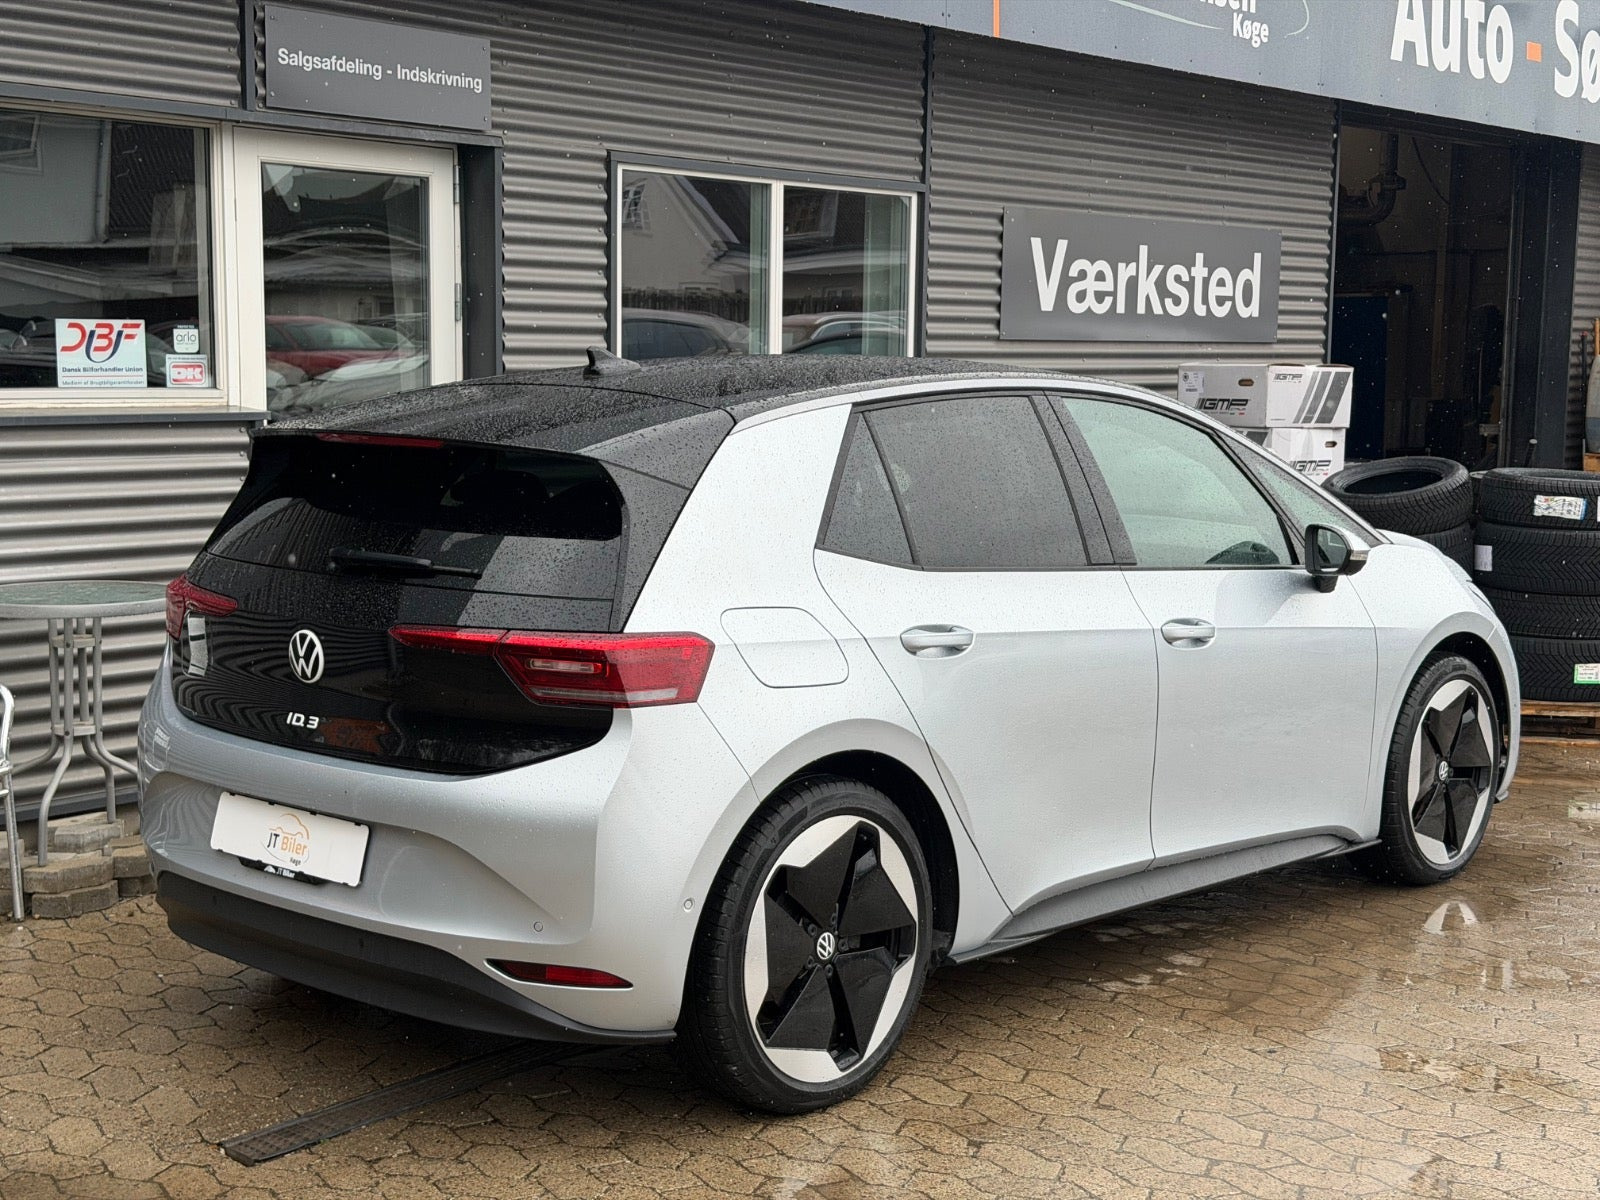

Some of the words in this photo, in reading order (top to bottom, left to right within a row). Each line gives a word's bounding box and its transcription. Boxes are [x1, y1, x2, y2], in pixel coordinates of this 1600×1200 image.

[1232, 12, 1269, 48] Køge
[1390, 0, 1514, 84] Auto
[277, 48, 382, 81] Salgsafdeling
[396, 64, 483, 93] Indskrivning
[1030, 236, 1262, 319] Værksted
[175, 331, 197, 342] arlo
[267, 832, 281, 849] JT
[280, 836, 308, 856] Biler
